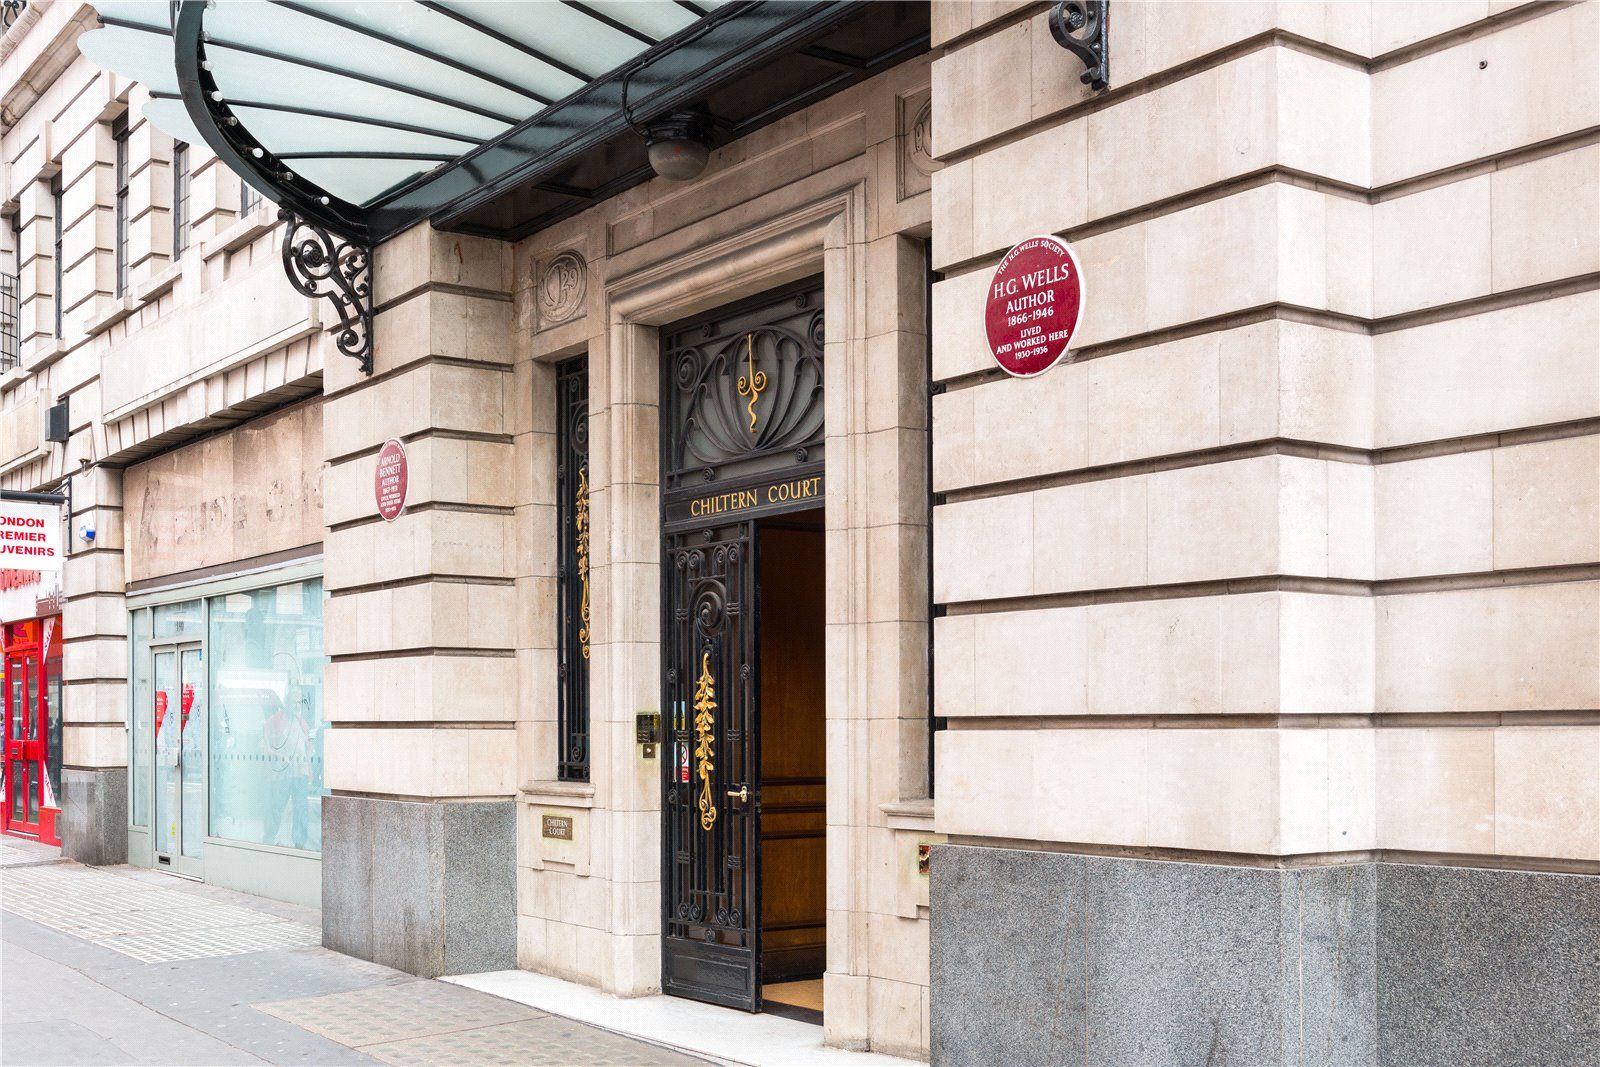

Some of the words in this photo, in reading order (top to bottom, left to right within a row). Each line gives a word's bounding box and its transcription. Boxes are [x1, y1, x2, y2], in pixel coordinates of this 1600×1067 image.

[998, 258, 1009, 275] THE
[1040, 240, 1065, 257] SOCIETY
[994, 278, 1019, 299] H.G.
[1021, 263, 1069, 290] WELLS
[1006, 289, 1055, 314] AUTHOR
[1007, 306, 1054, 326] 1866-1946
[996, 343, 1012, 355] AND
[1013, 334, 1046, 351] WORKED
[1048, 329, 1069, 341] HERE
[1020, 325, 1041, 339] LIVED
[381, 453, 400, 466] ARNOLD
[380, 464, 401, 478] BENNETT
[381, 475, 400, 486] AUTHOR
[690, 489, 757, 517] CHILTERN
[768, 477, 821, 503] COURT
[549, 828, 566, 836] COURT
